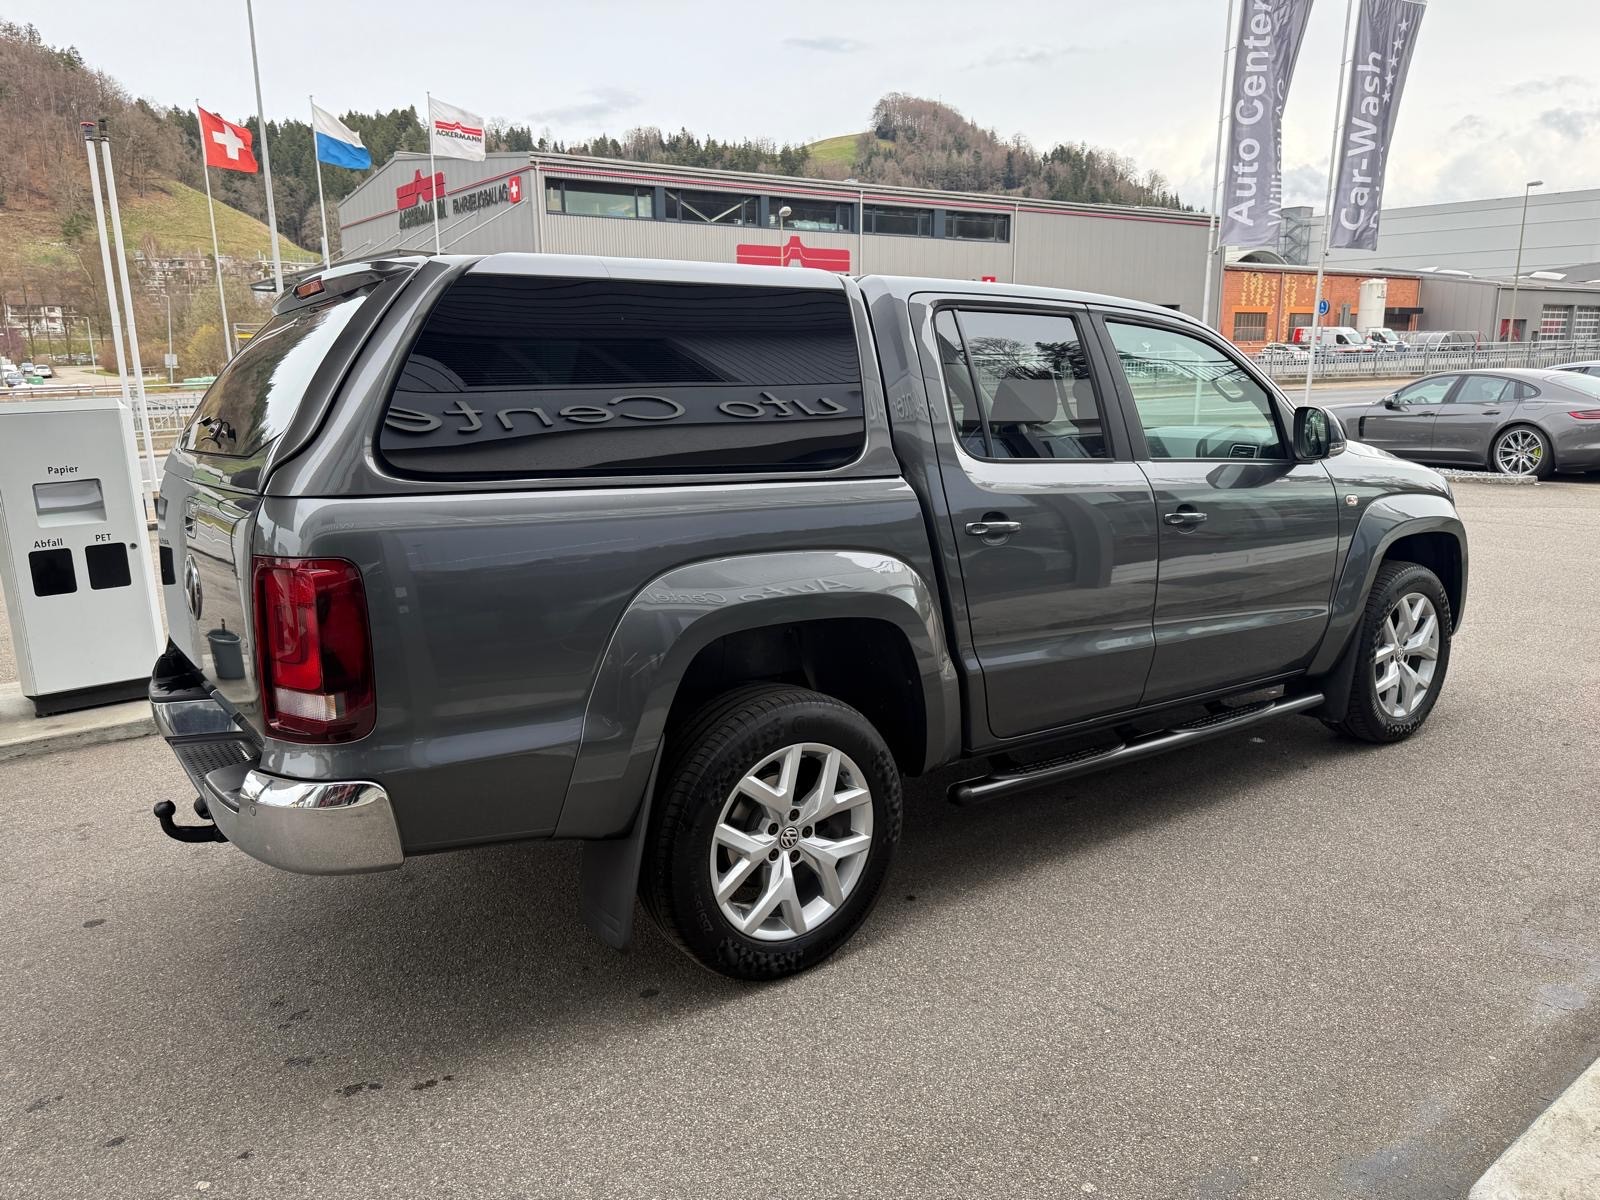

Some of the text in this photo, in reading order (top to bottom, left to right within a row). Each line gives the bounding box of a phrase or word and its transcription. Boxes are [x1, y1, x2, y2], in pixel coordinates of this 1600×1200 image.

[1227, 0, 1273, 226] Auto Center
[436, 129, 482, 144] ACKERMANN
[1340, 51, 1382, 231] Car-Wash
[47, 465, 79, 476] Papier
[33, 538, 63, 549] Abfall
[95, 533, 112, 542] PET
